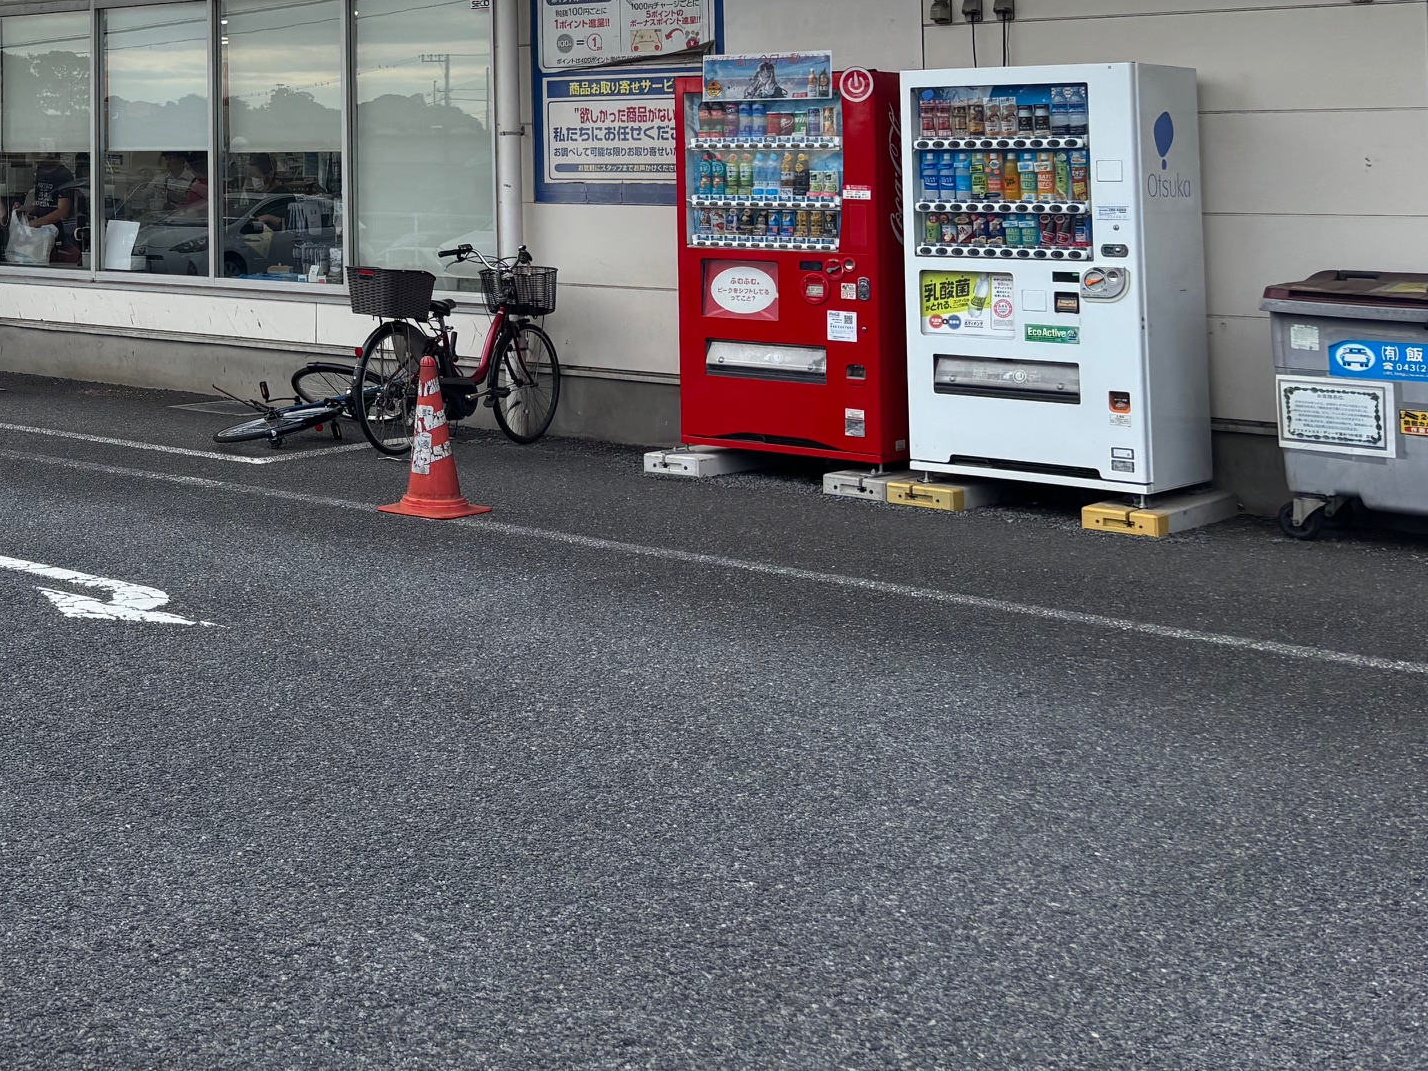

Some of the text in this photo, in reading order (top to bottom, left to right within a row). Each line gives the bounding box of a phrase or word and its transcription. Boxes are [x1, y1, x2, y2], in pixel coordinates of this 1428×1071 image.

[553, 146, 676, 157] お調べして可能な限りお取り寄せい
[1147, 173, 1191, 197] Otsuka
[924, 277, 971, 303] 乳酸菌
